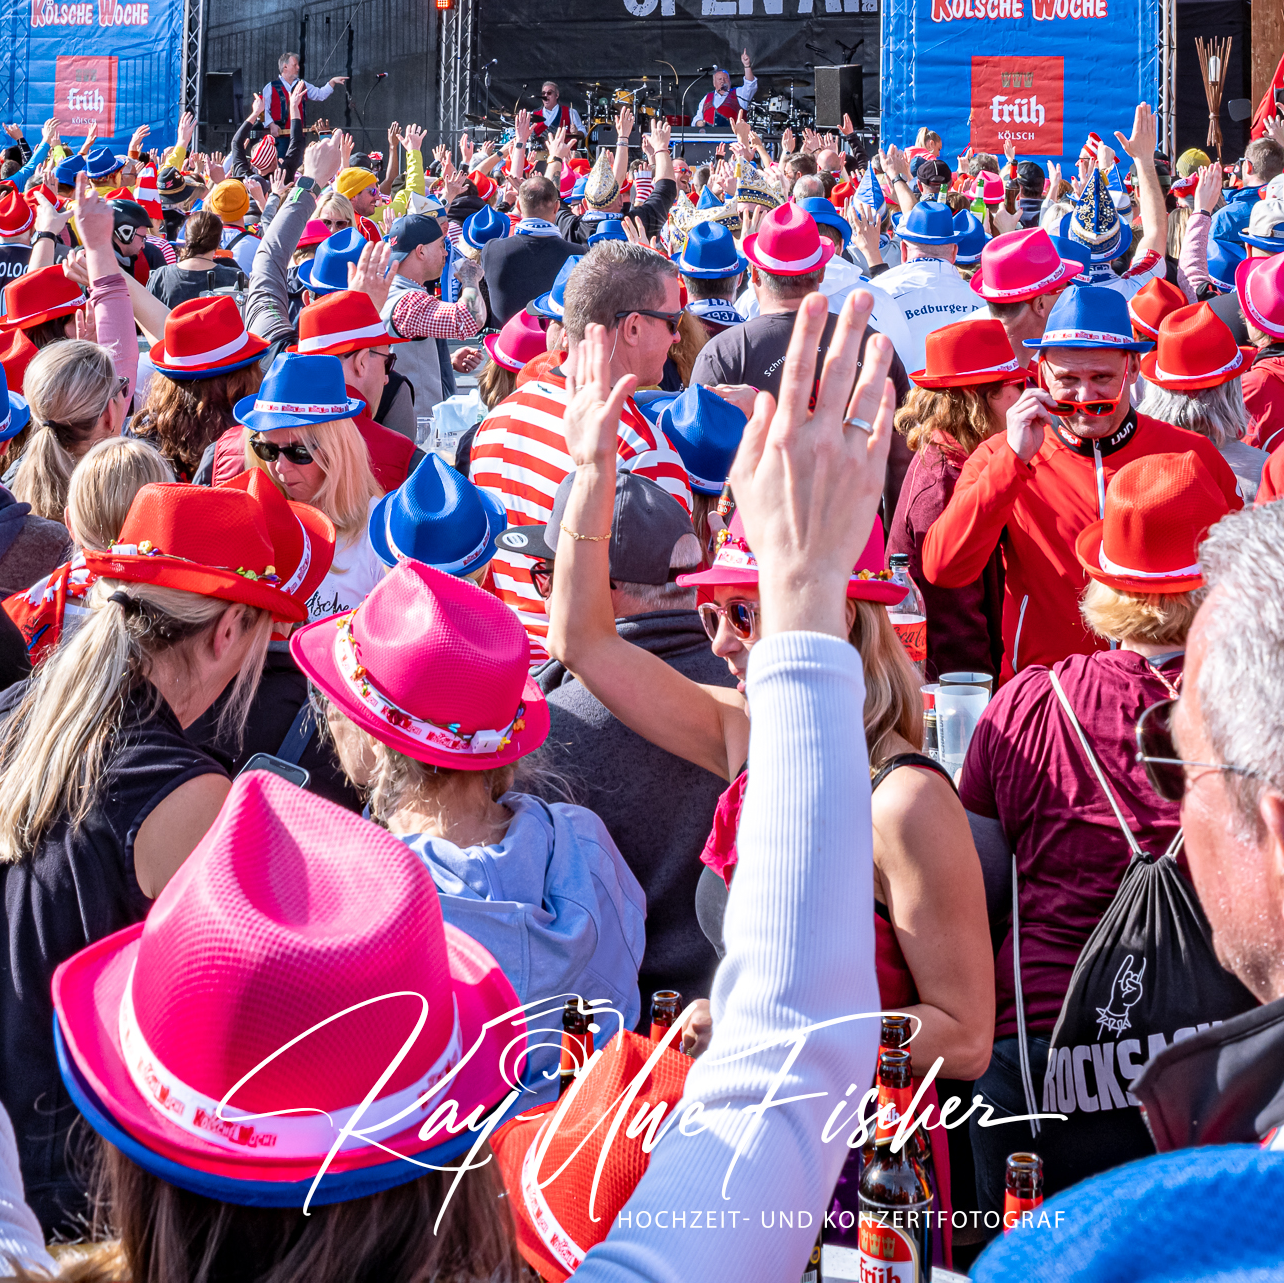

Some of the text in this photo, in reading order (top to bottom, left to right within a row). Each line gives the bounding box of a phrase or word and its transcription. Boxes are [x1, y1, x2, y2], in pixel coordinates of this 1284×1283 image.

[998, 130, 1035, 141] KÖLSCH
[905, 304, 968, 321] Bedburger
[1042, 1020, 1223, 1114] ROCKS
